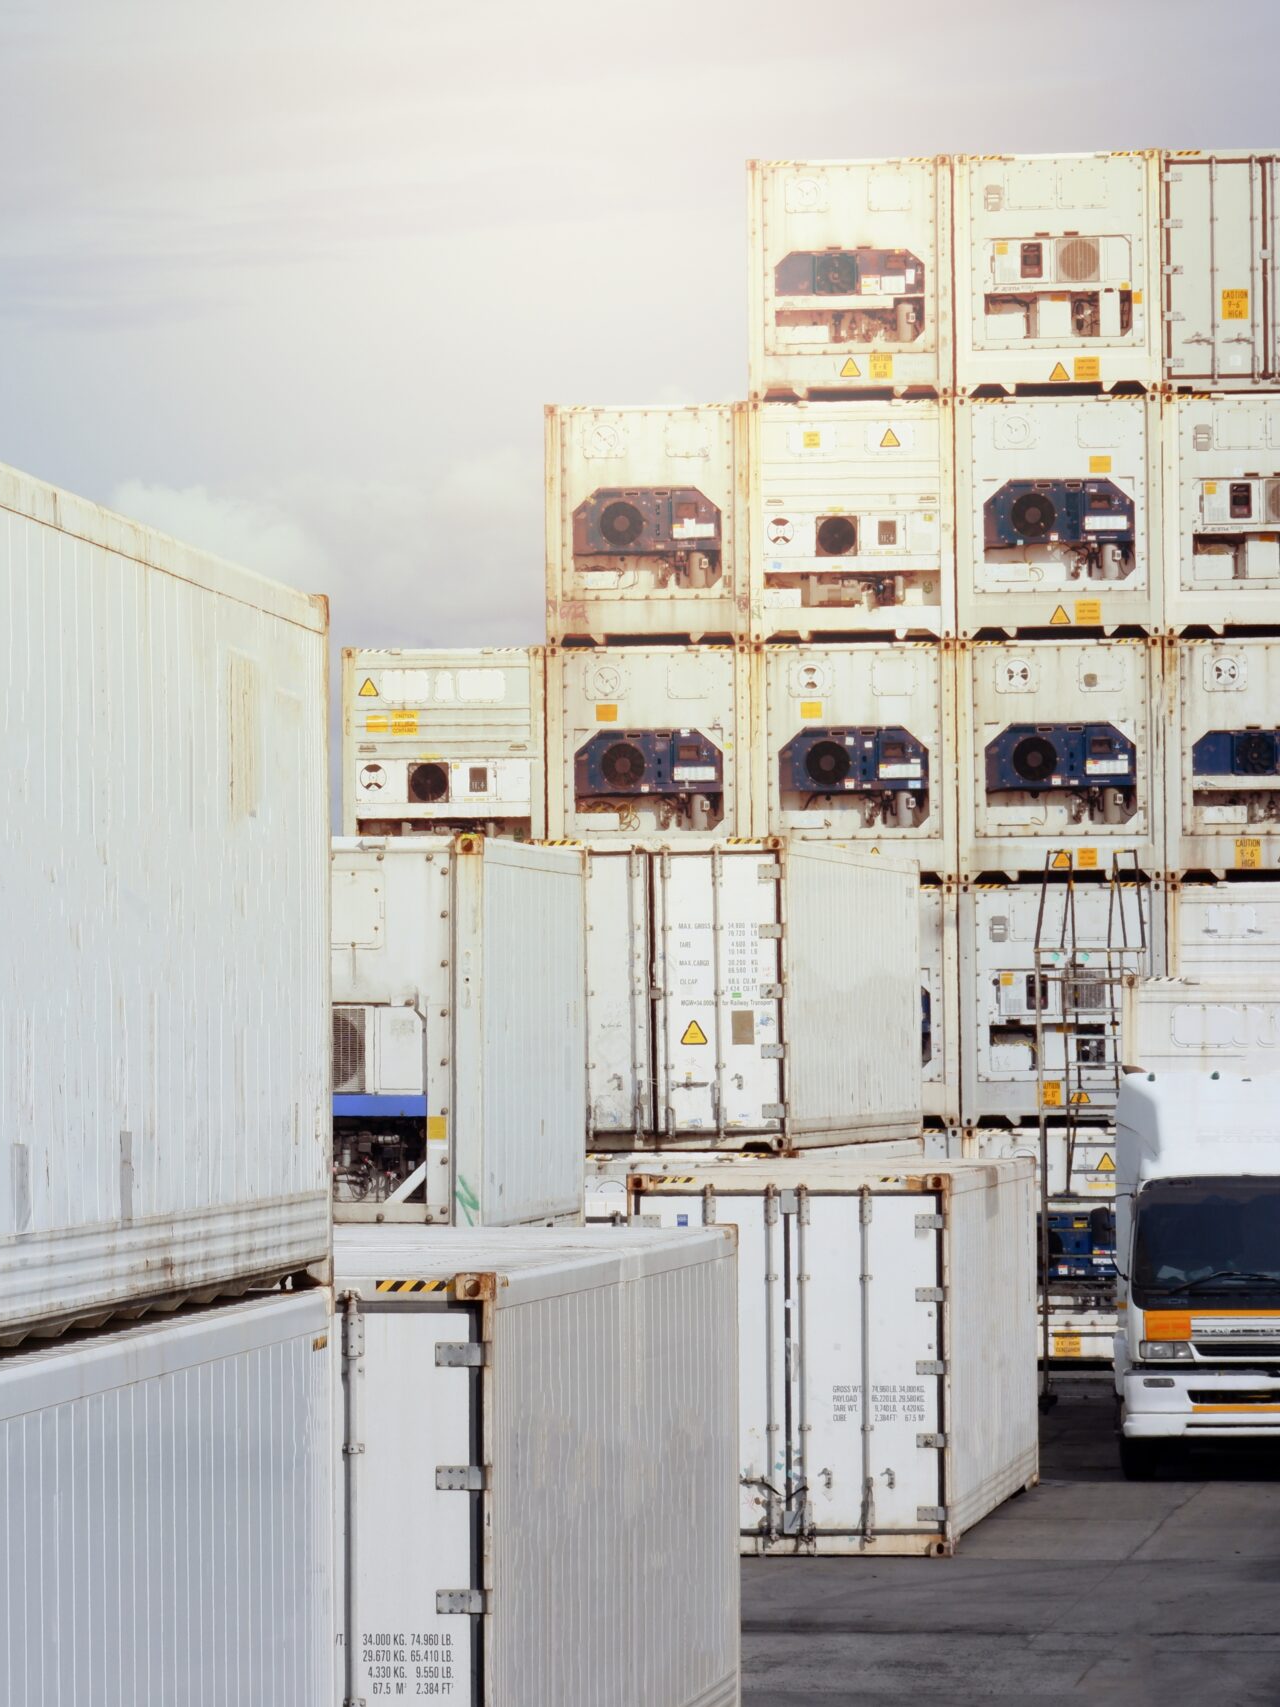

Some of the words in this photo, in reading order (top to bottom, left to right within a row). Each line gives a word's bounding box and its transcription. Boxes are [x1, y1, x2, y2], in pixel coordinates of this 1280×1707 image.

[833, 1404, 847, 1412] TARE
[363, 1634, 391, 1646] 34.000
[393, 1634, 408, 1646] KG.
[411, 1634, 439, 1646] 74.960
[441, 1634, 454, 1646] LB.
[363, 1650, 391, 1662] 29.670
[393, 1650, 408, 1662] KG.
[410, 1650, 439, 1662] 65.410
[441, 1650, 454, 1662] LB.
[368, 1666, 391, 1678] 4.330
[393, 1666, 408, 1678] KG.
[416, 1666, 439, 1678] 9.550
[441, 1666, 454, 1678] LB.
[372, 1683, 391, 1695] 67.5
[416, 1683, 439, 1695] 2.384
